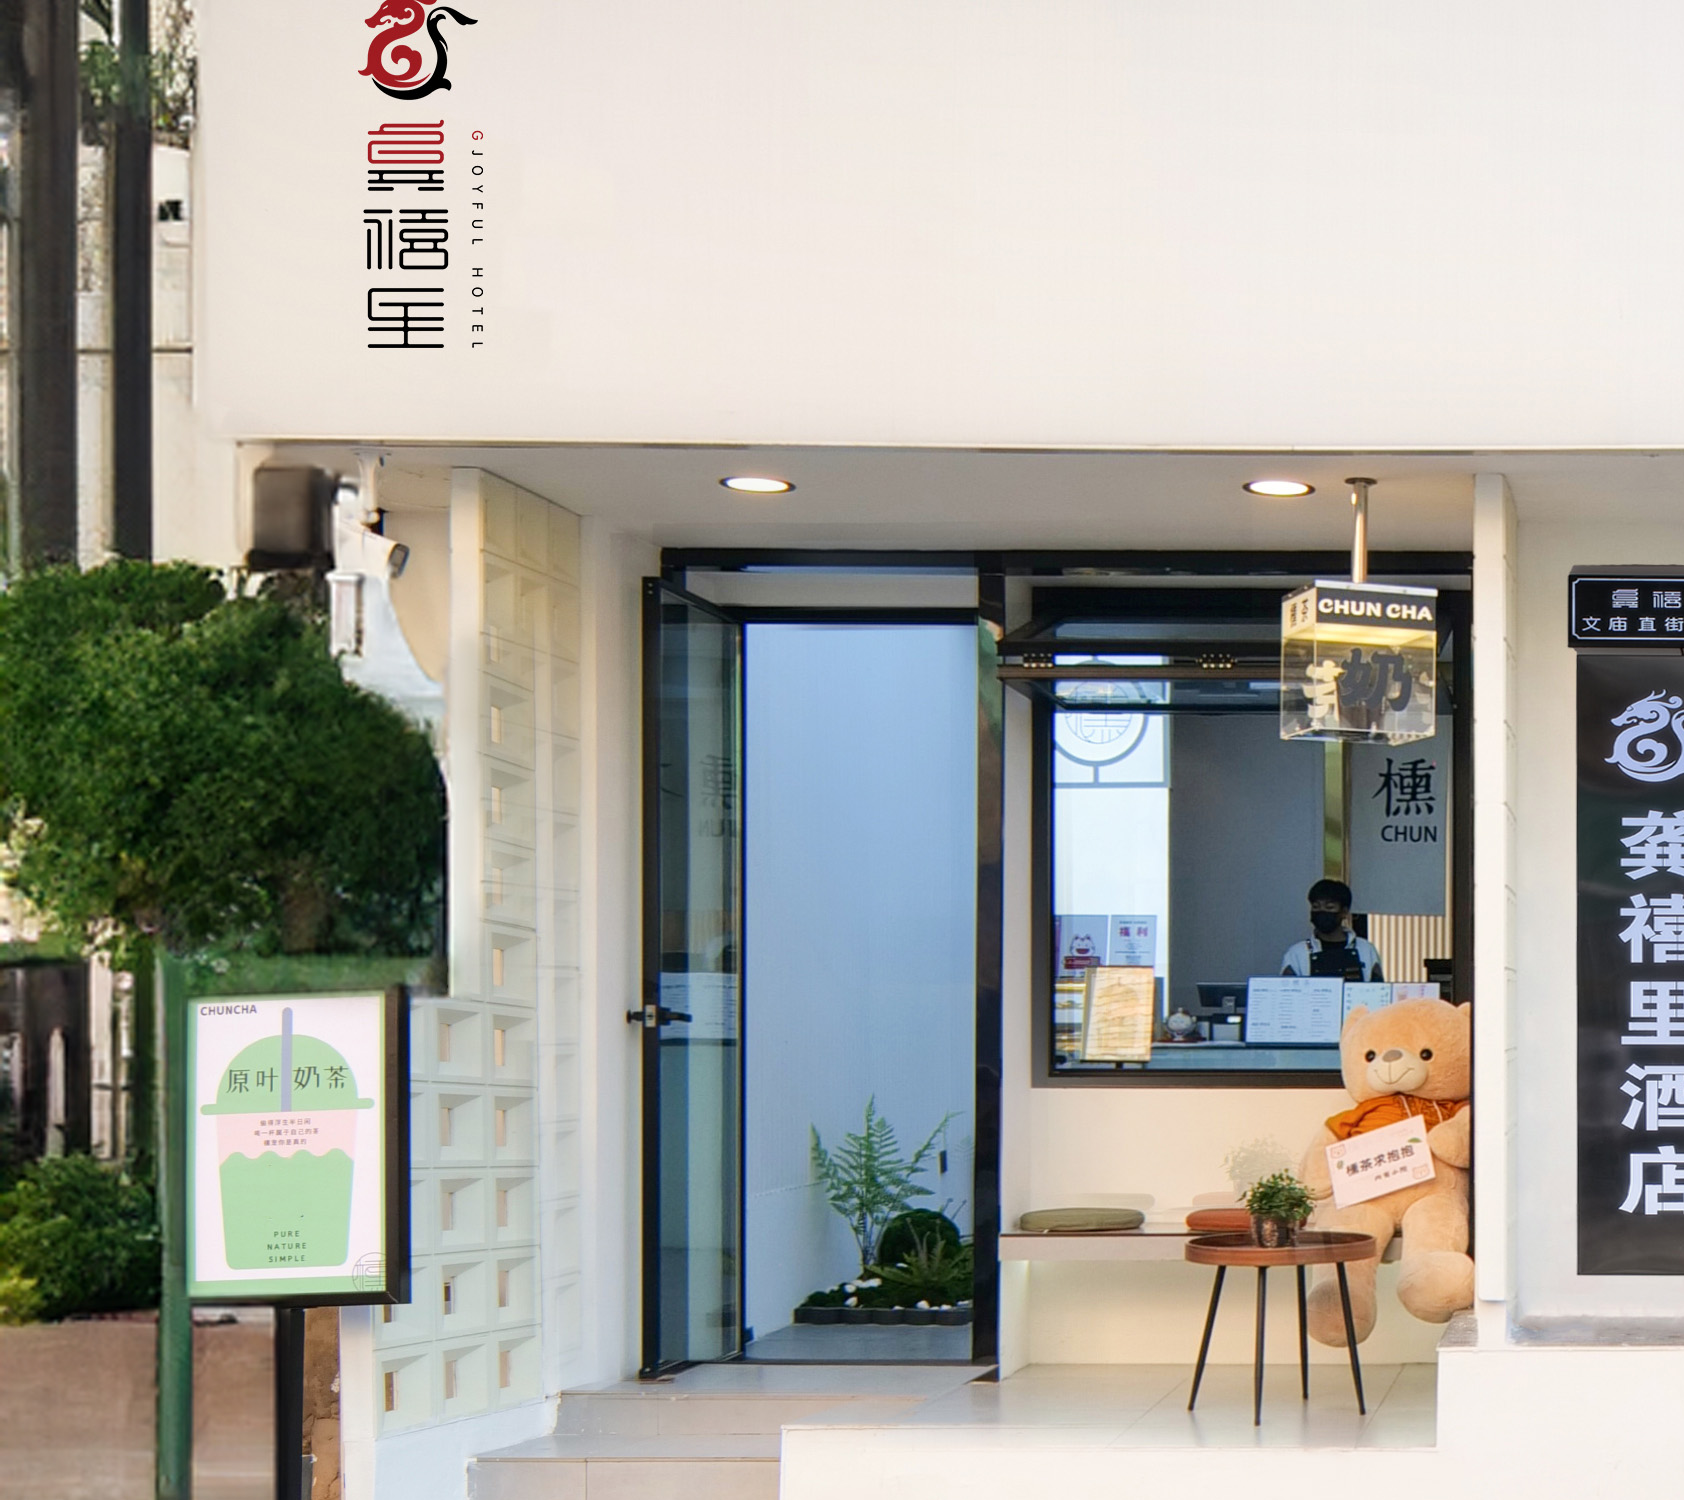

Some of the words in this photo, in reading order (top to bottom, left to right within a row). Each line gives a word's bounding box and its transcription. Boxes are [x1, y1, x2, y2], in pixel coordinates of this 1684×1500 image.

[471, 266, 484, 349] HOTEL
[1318, 598, 1382, 617] CHUN
[1385, 602, 1433, 621] CHA
[1381, 825, 1438, 842] CHUN
[200, 1004, 257, 1016] CHUNCHA
[273, 1230, 300, 1238] PURE
[267, 1242, 307, 1250] NATURE
[268, 1254, 306, 1263] SIMPLE
